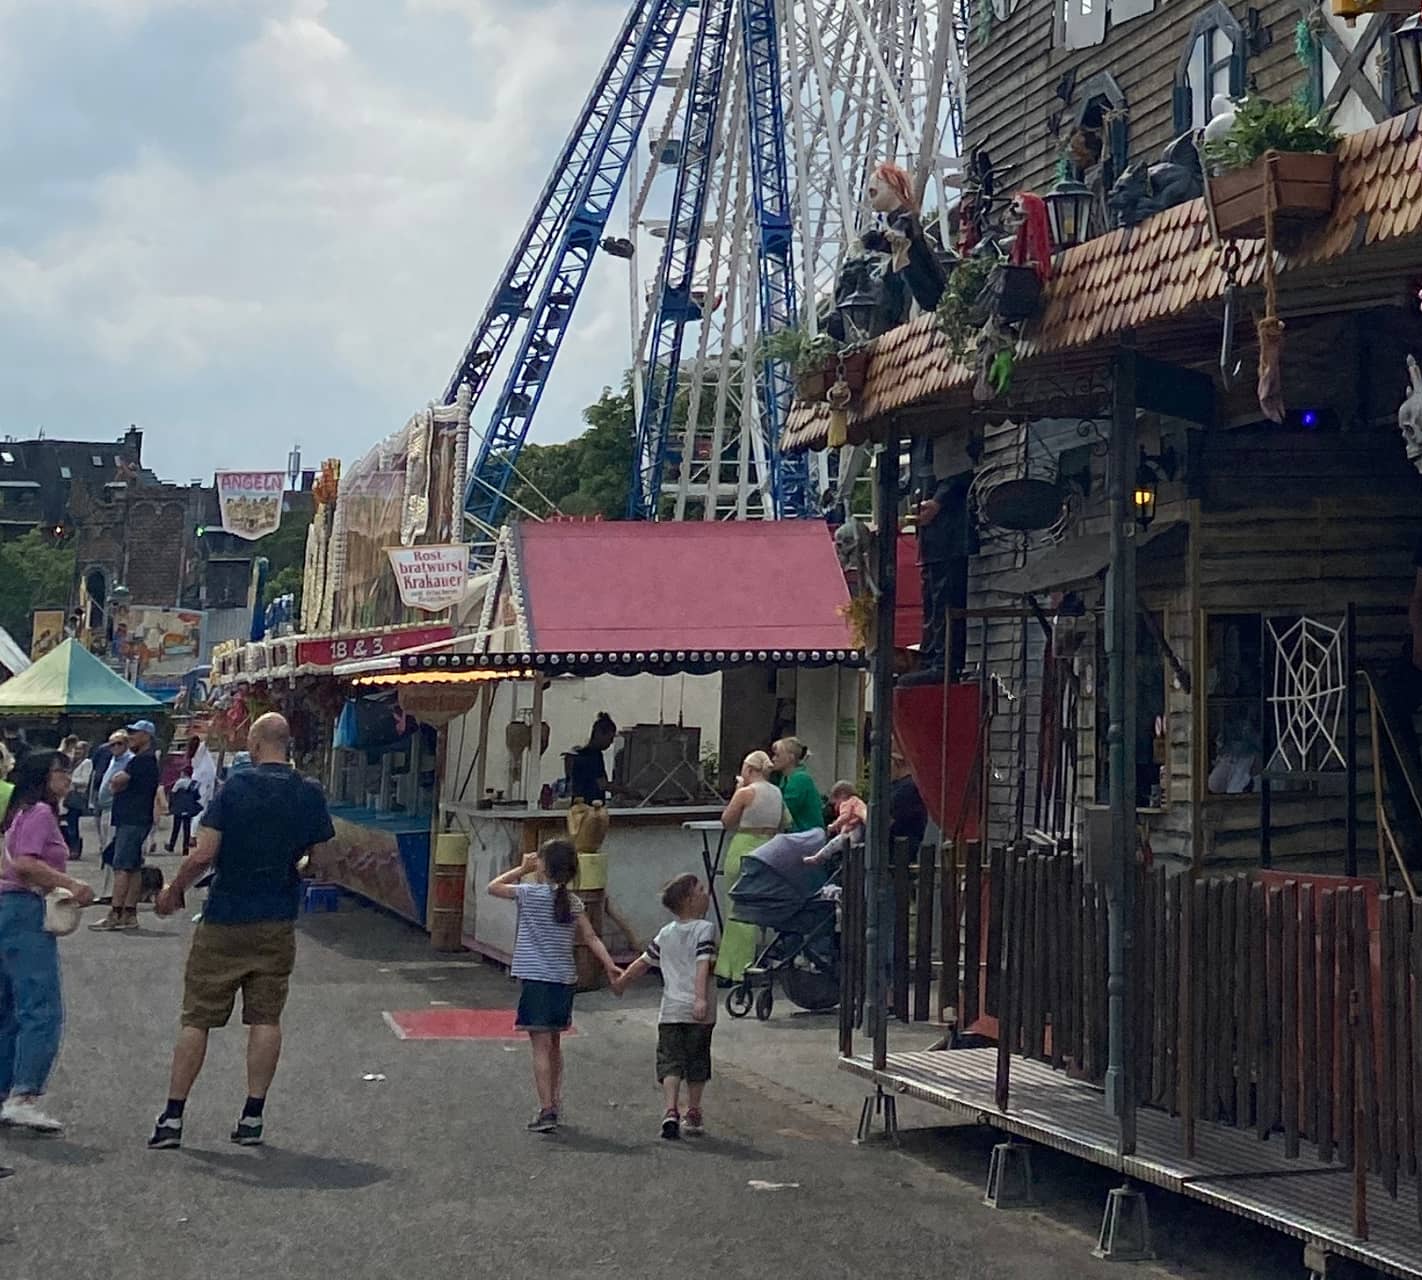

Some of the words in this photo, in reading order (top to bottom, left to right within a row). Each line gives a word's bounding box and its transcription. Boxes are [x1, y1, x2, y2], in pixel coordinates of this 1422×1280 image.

[221, 473, 283, 490] ANGELN
[399, 560, 463, 574] bratwurst
[403, 574, 463, 590] Krakauer
[330, 641, 348, 659] 18
[353, 639, 369, 657] &
[372, 637, 384, 654] 3
